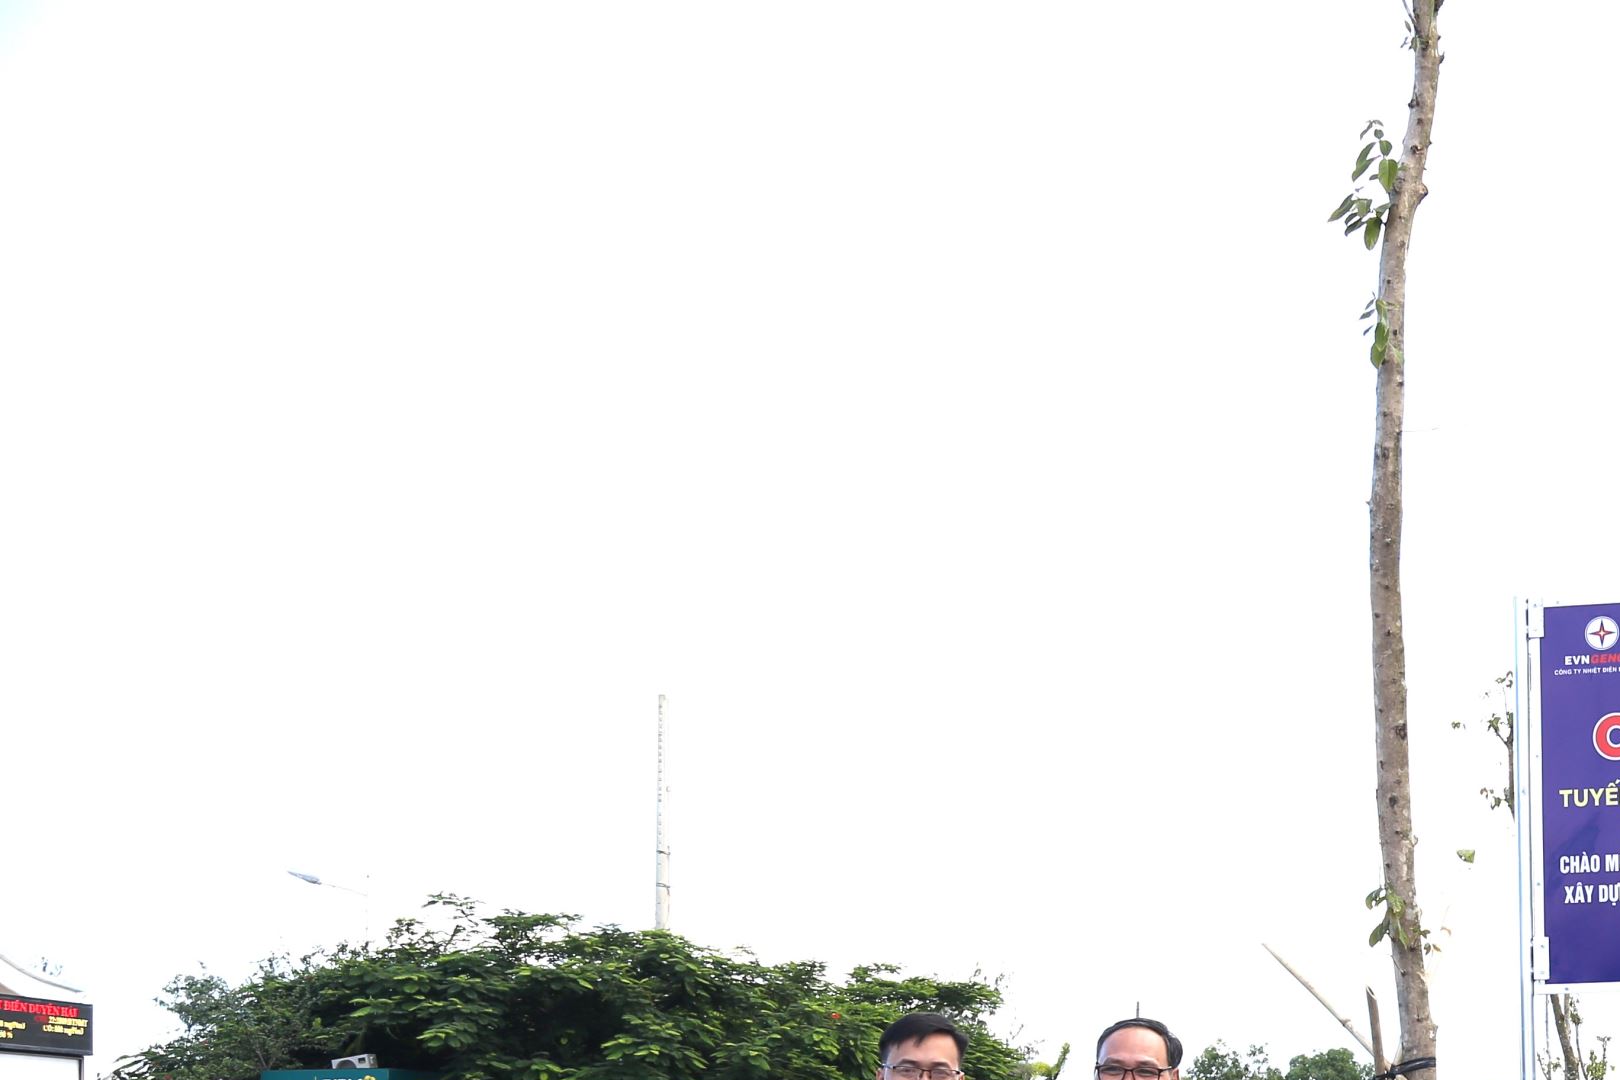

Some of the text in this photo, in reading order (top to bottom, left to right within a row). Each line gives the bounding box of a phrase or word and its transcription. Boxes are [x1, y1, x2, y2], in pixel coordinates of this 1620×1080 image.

[1554, 668, 1573, 676] CÔNG
[1560, 852, 1600, 873] CHÀO
[1565, 882, 1593, 903] XÂY
